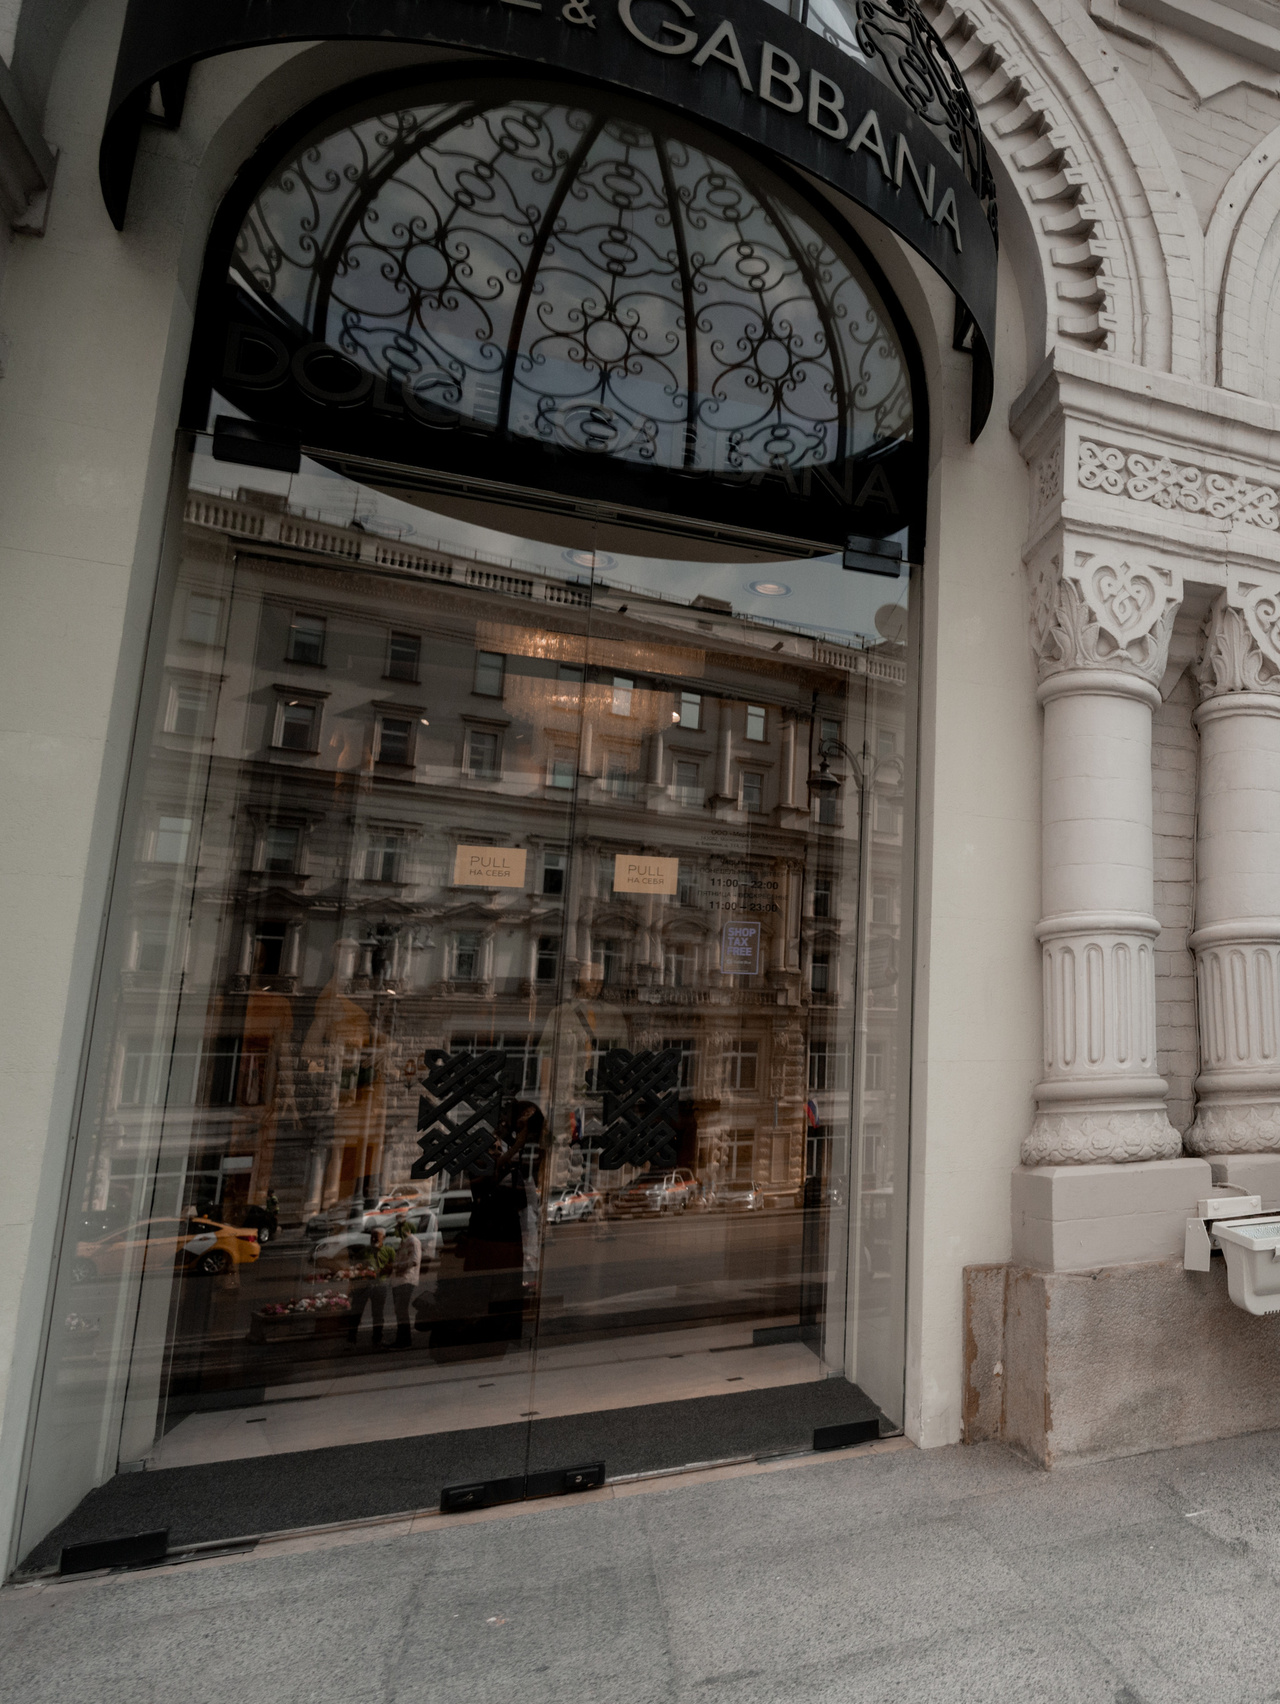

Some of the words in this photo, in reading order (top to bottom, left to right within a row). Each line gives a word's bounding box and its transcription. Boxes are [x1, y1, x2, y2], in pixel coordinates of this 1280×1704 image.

[617, 0, 961, 254] GABBANA
[470, 856, 511, 868] PULL
[628, 864, 664, 877] PULL
[710, 878, 739, 887] 11:00
[750, 880, 779, 889] 22:00
[709, 901, 738, 910] 11:00
[749, 903, 778, 912] 23:00
[727, 927, 756, 937] SHOP
[727, 937, 748, 946] TAX
[726, 947, 752, 956] FREE
